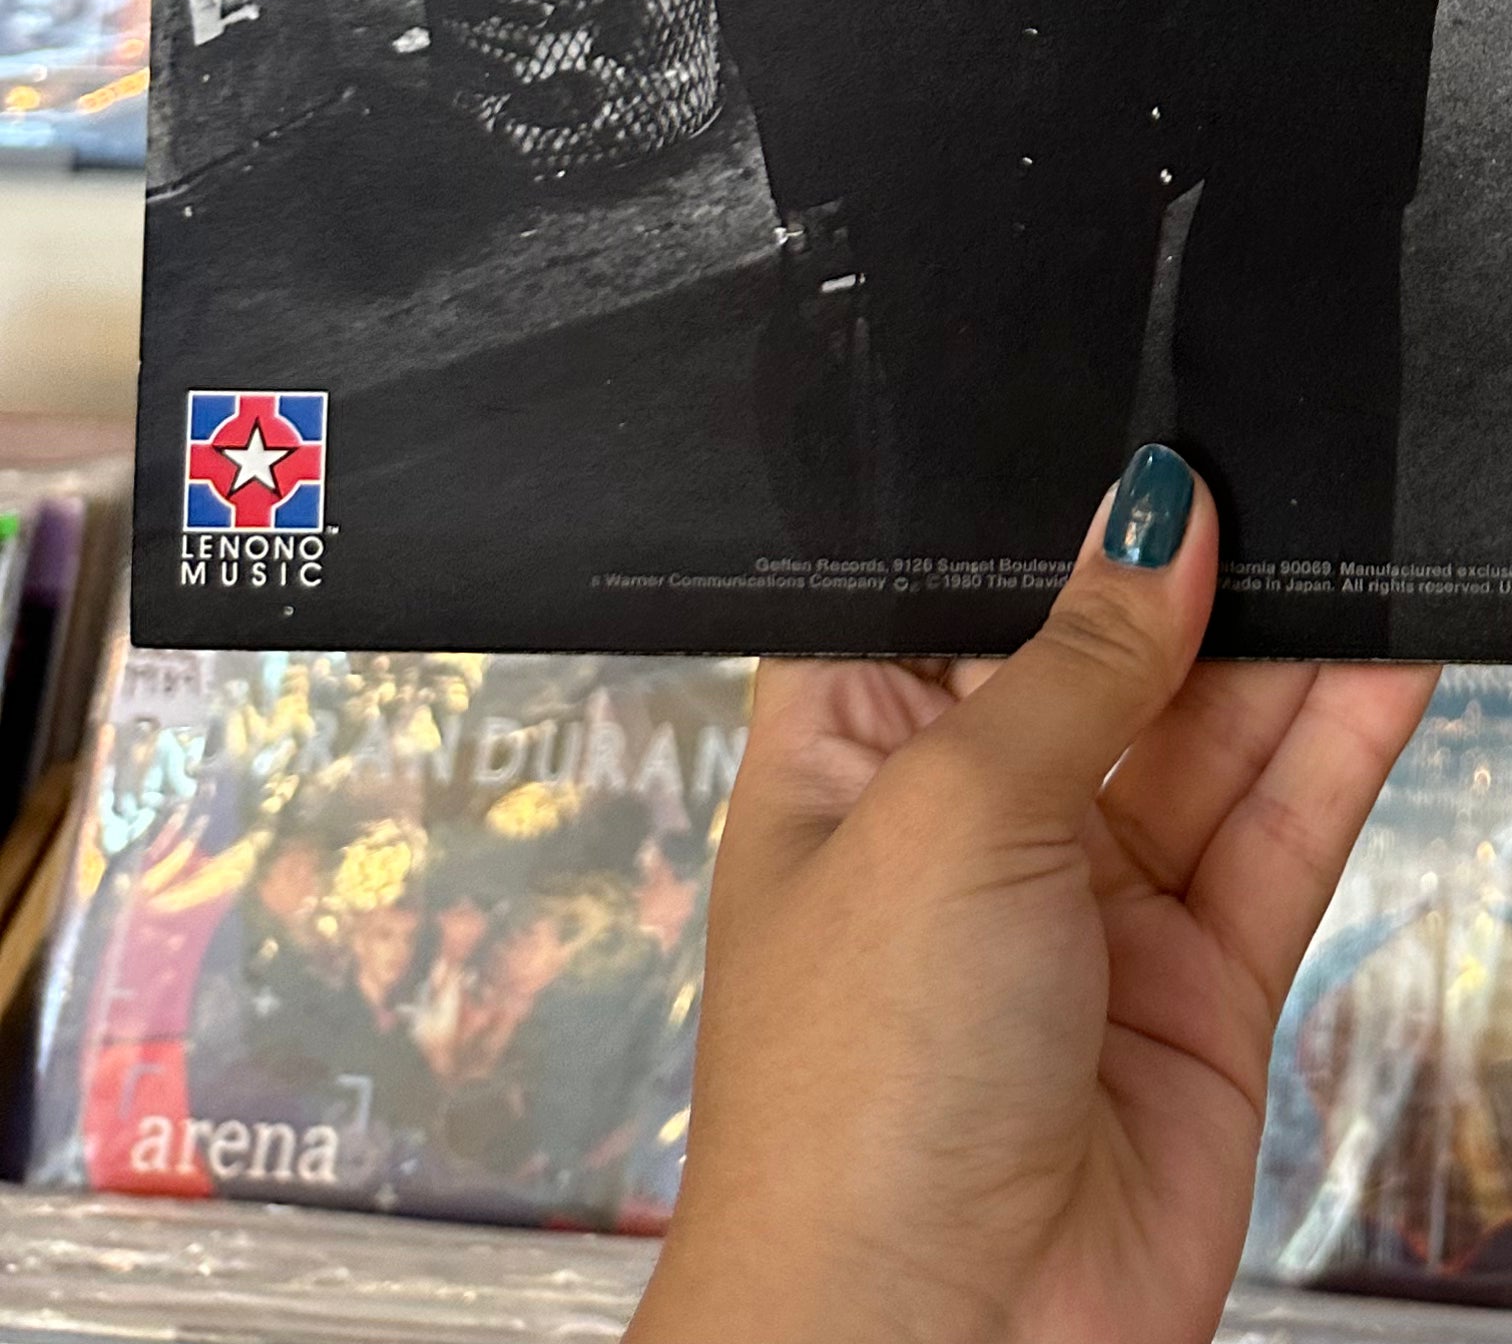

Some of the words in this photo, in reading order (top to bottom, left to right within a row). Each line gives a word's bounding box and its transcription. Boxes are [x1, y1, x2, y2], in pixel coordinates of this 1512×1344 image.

[182, 535, 324, 560] LENONO
[756, 556, 812, 572] Geffen
[893, 558, 934, 572] 9126
[938, 558, 995, 572] Sunset
[999, 558, 1073, 572] Boulevar
[1340, 562, 1452, 577] Manufactured
[181, 562, 323, 587] MUSIC
[606, 573, 665, 588] Warner
[668, 573, 806, 588] Communications
[808, 573, 887, 591] Company
[988, 574, 1018, 588] The
[1022, 574, 1069, 589] David
[1341, 580, 1365, 593] All
[1369, 580, 1415, 596] rights
[129, 1111, 342, 1183] arena
